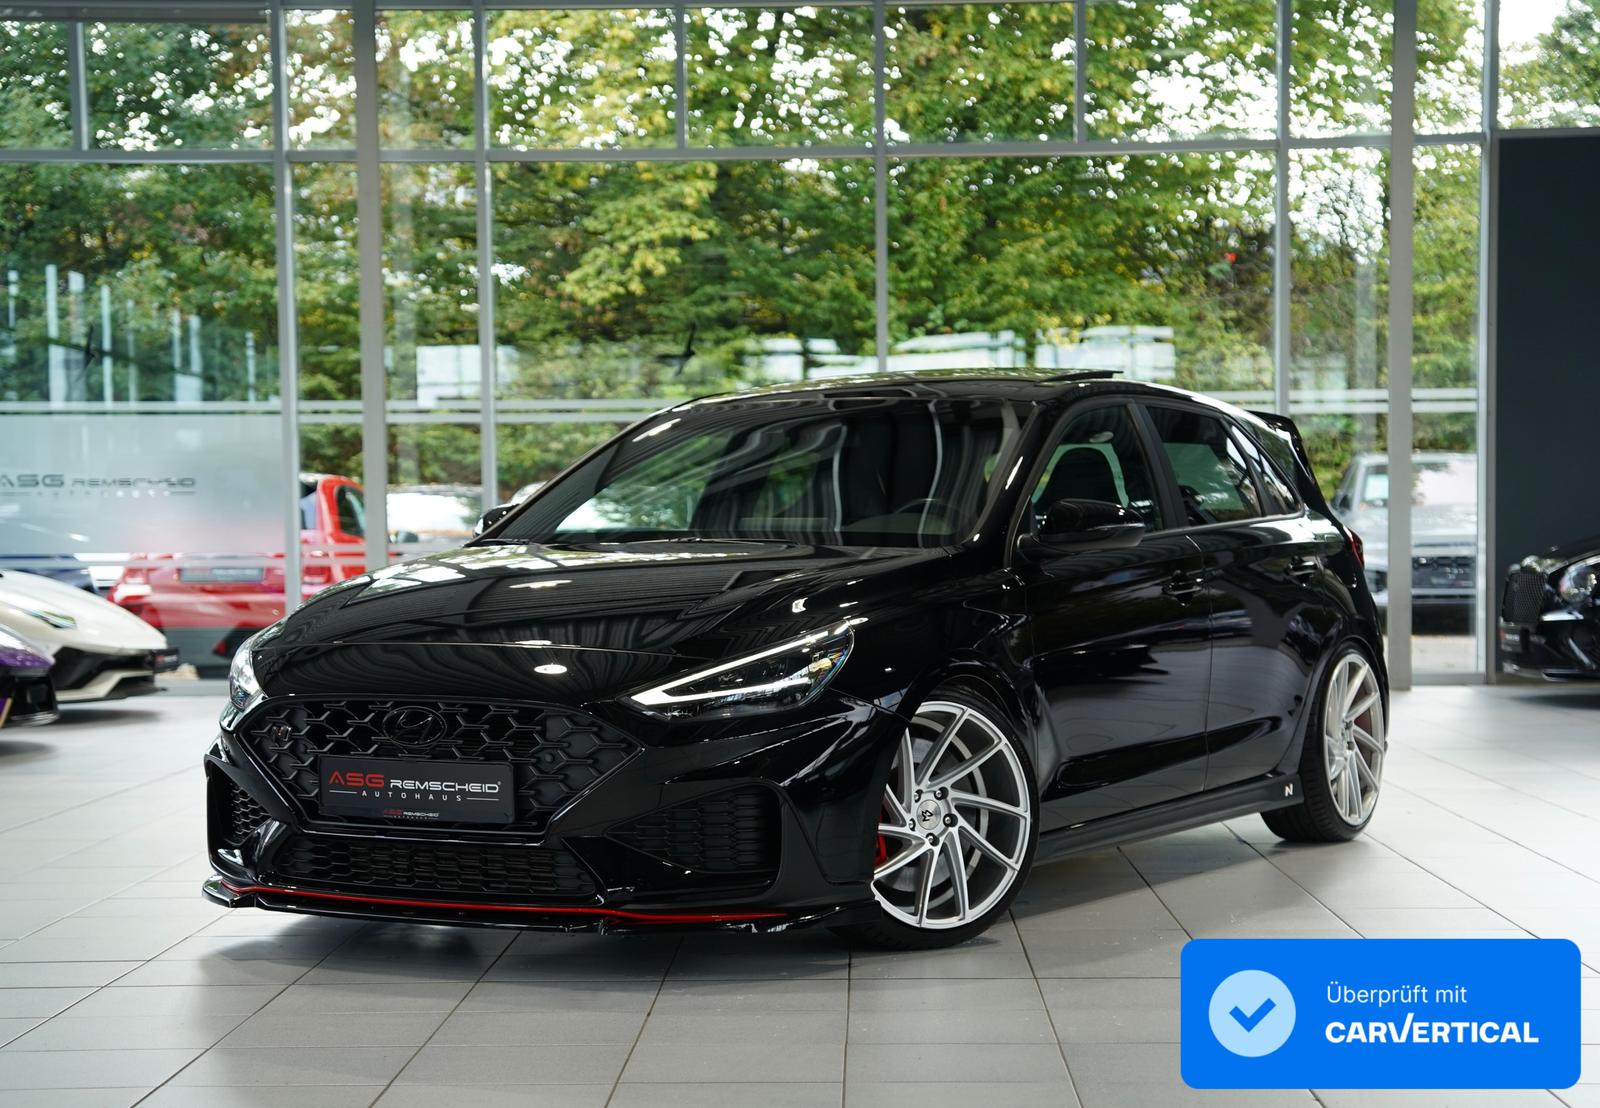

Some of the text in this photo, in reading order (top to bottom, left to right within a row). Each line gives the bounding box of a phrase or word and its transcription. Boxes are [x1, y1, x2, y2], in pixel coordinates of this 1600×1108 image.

[328, 770, 385, 788] ASG
[362, 790, 462, 802] AUTOHAUS
[1284, 783, 1294, 797] N
